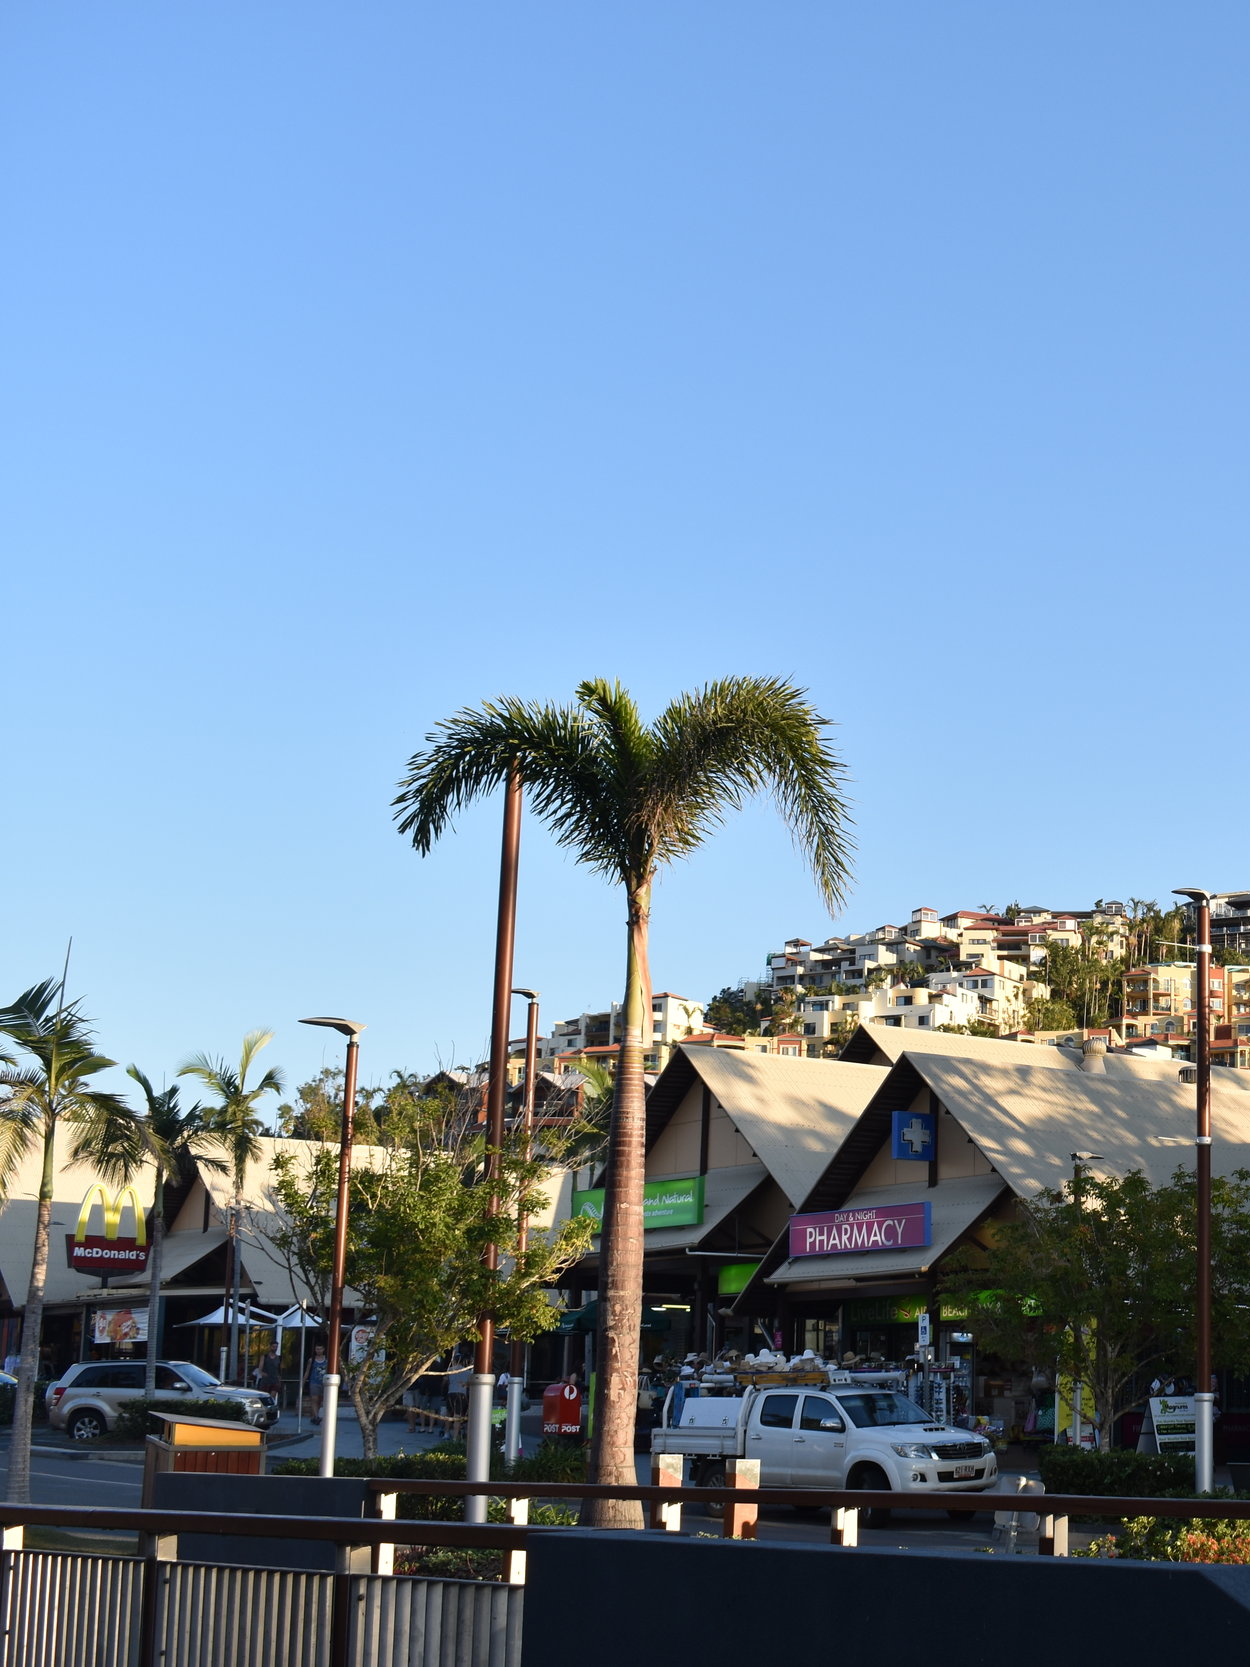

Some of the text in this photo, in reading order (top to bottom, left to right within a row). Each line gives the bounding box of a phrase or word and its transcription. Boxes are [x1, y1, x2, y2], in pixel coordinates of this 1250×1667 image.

[643, 1191, 693, 1206] and Natural
[834, 1210, 877, 1223] DAY & NIGHT
[806, 1219, 906, 1252] PHARMACY
[73, 1247, 146, 1260] McDonald's
[543, 1424, 581, 1433] POST POST
